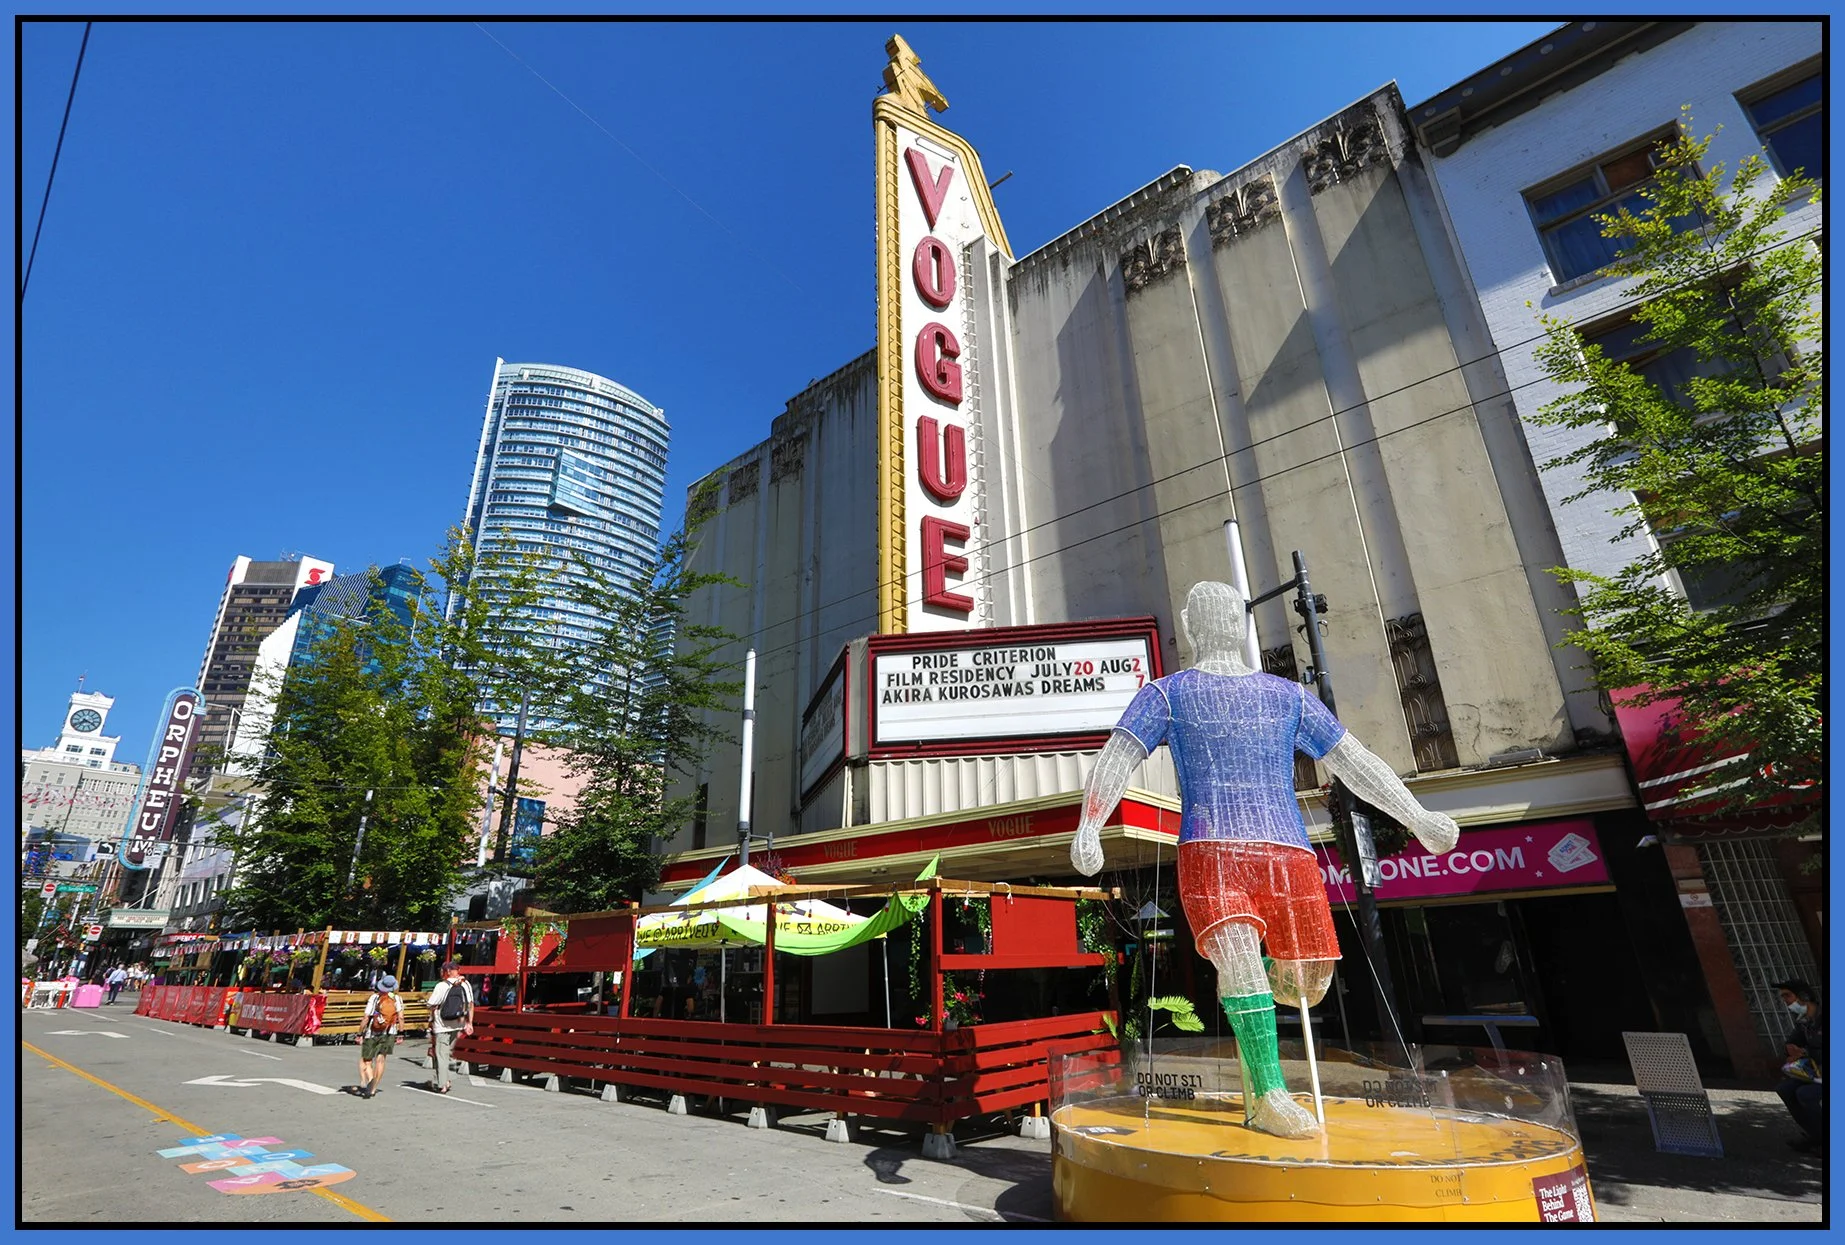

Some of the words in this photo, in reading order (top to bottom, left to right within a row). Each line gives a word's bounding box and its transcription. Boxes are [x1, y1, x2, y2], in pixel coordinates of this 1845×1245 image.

[904, 147, 975, 614] VOGUE
[912, 653, 958, 670] PRIDE
[972, 647, 1056, 666] CRITERION
[887, 672, 923, 687] FILM
[929, 666, 1015, 685] RESIDENCY
[882, 687, 932, 704] AKIRA
[939, 681, 1034, 701] KUROSAWAS
[1041, 677, 1105, 694] DREAMS
[132, 700, 193, 853] ORPHEUM
[987, 815, 1035, 838] VOGUE
[823, 840, 858, 860] VOGUE
[1137, 1072, 1151, 1085] DO
[1155, 1073, 1178, 1086] NOT
[1181, 1074, 1202, 1088] SIT
[1138, 1085, 1153, 1098] OR
[1156, 1086, 1196, 1100] CLIMB
[1430, 1175, 1443, 1183] DO
[1445, 1174, 1460, 1183] NOT
[1435, 1189, 1462, 1197] CLIMB
[1539, 1187, 1553, 1199] The
[1553, 1183, 1568, 1197] Light
[1542, 1196, 1565, 1211] Behind
[1544, 1211, 1558, 1222] The
[1558, 1208, 1574, 1221] Game
